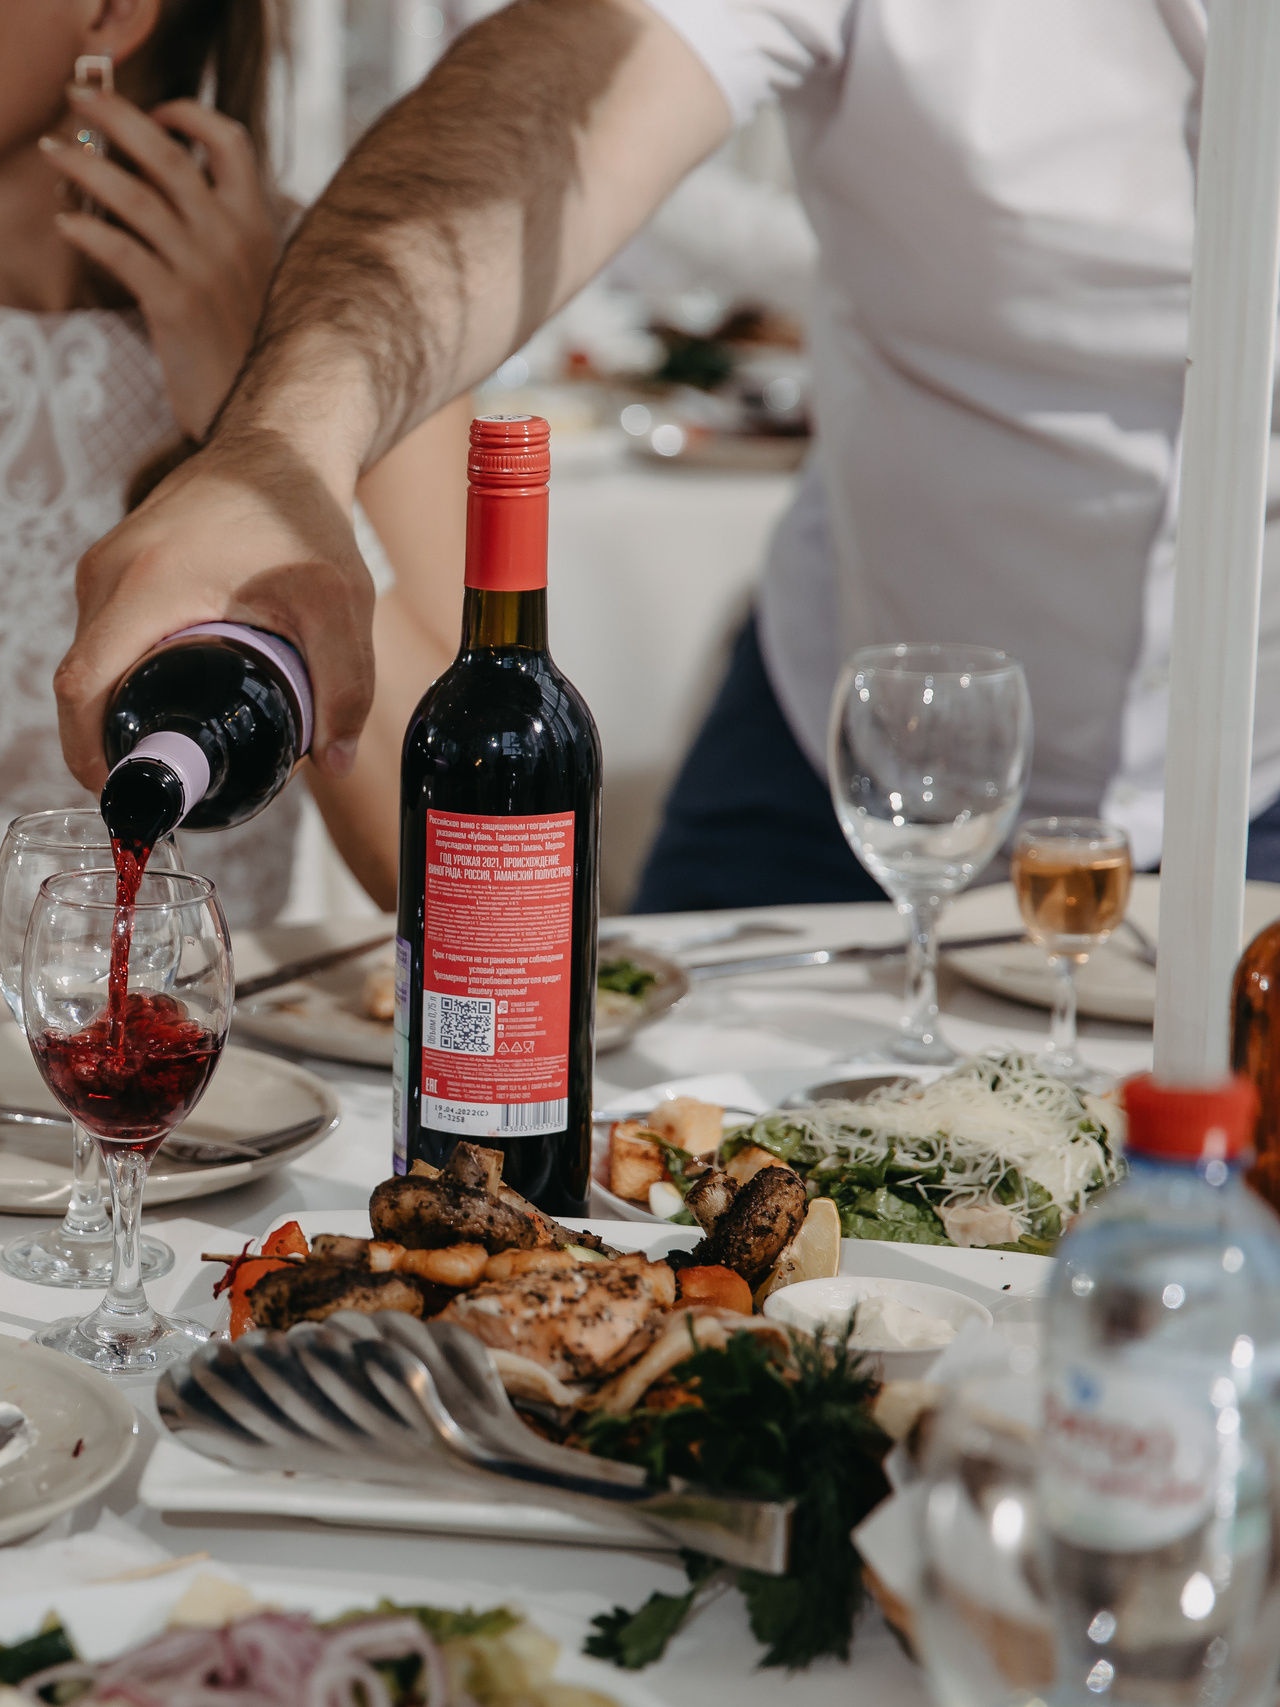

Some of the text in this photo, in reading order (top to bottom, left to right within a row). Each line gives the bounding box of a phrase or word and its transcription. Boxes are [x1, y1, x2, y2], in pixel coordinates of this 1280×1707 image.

[429, 815, 459, 828] Российское
[481, 822, 525, 831] защищенным
[527, 819, 573, 832] географическим
[436, 829, 565, 842] указанием «Кубань. Таманский полуостров»
[436, 840, 472, 852] полусладкое
[500, 843, 519, 852] «Шато
[440, 852, 560, 869] ГОД УРОЖАЯ 2021, ПРОИСХОЖДЕНИЕ
[429, 863, 571, 882] ВИНОГРАДА: РОССИЯ, ТАМАНСКИЙ ПОЛУОСТРОВ
[433, 948, 444, 959] Срок
[446, 953, 473, 963] годности
[483, 955, 516, 965] ограничен
[517, 956, 528, 965] при
[529, 953, 563, 964] соблюдении
[434, 970, 561, 986] Чрезмерное употребление алкоголя вредит
[469, 966, 494, 975] условий
[468, 987, 527, 997] вашему здоровью!
[428, 1003, 437, 1018] 0,75
[427, 1020, 436, 1044] Объем
